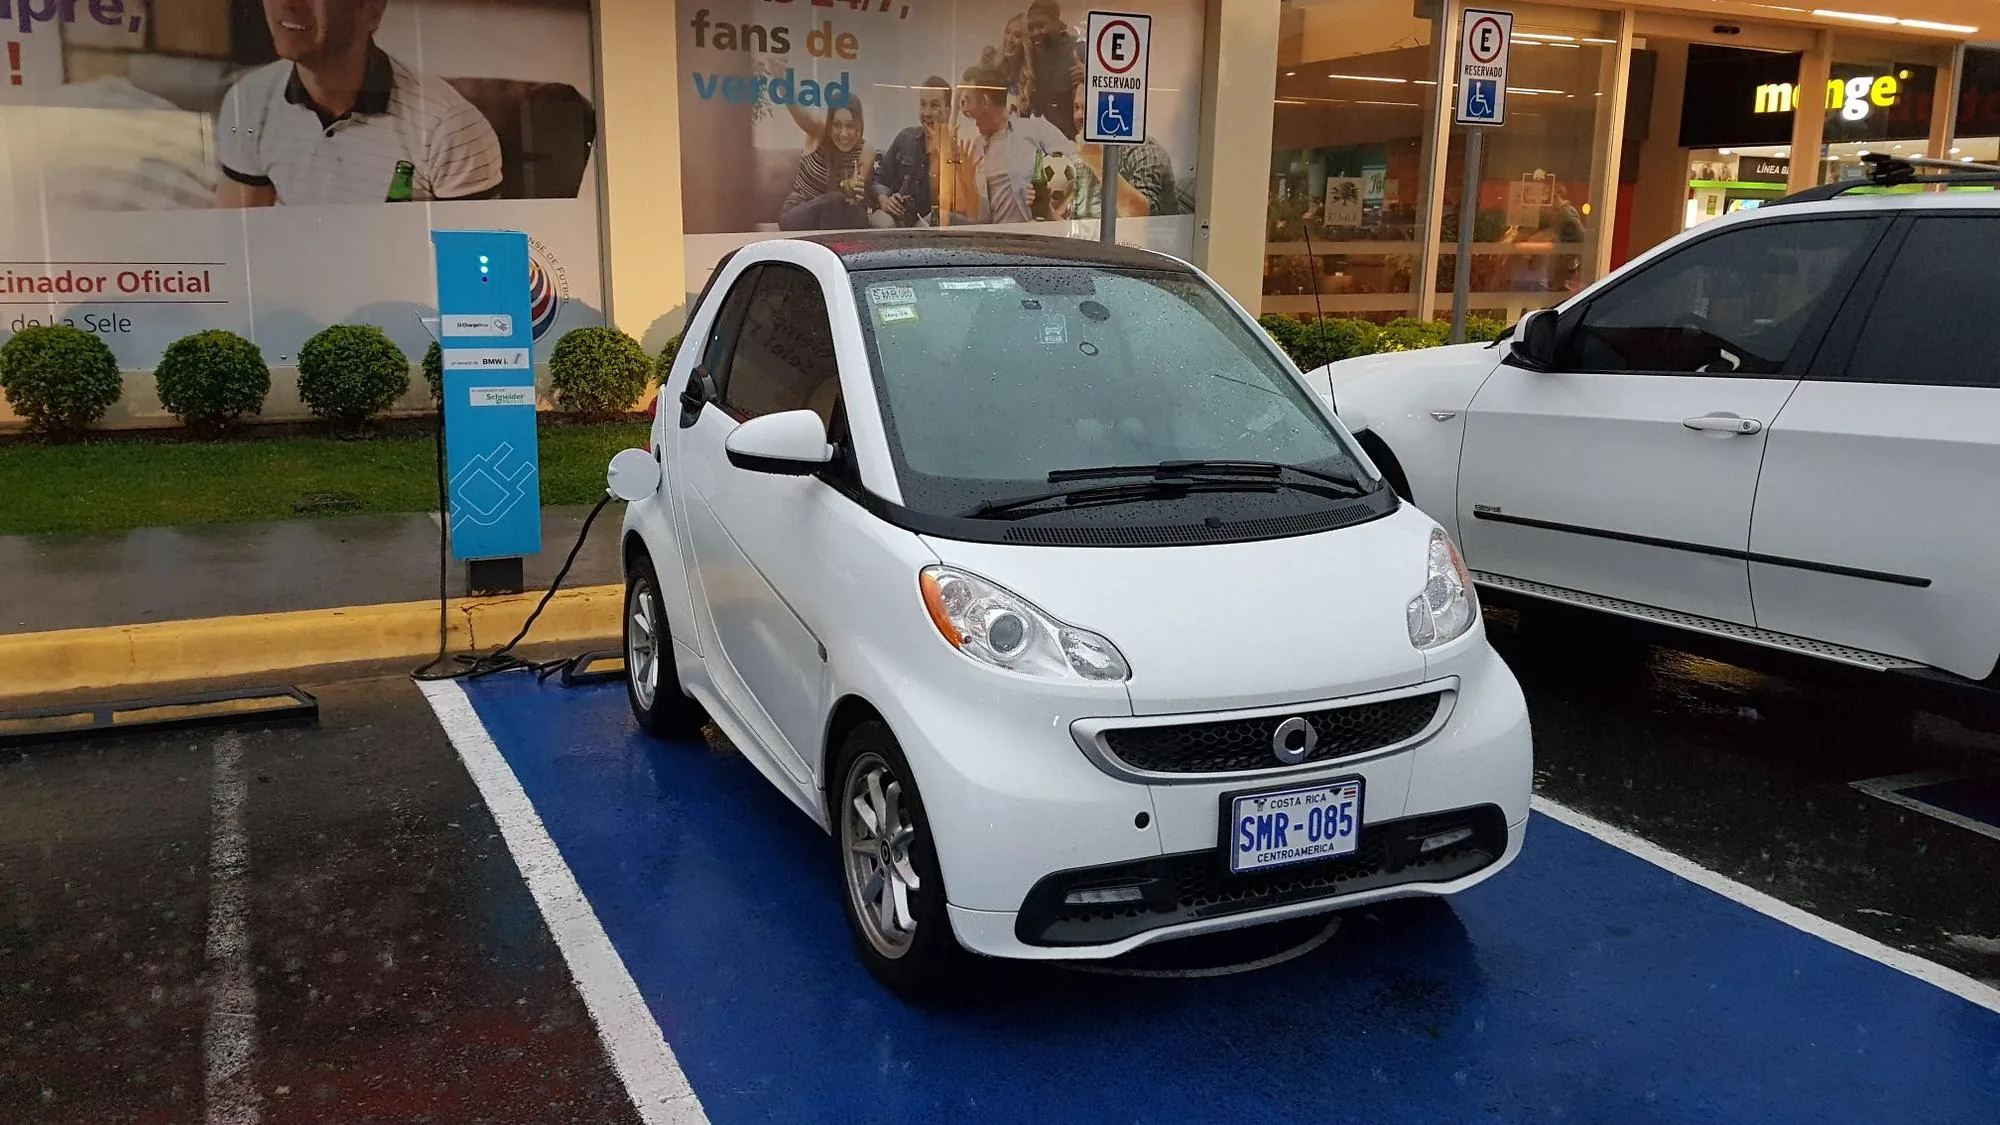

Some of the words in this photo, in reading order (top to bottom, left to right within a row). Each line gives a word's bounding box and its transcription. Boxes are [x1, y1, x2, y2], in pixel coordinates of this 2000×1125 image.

[0, 0, 142, 33] pre,
[690, 8, 791, 54] fans
[806, 20, 859, 60] de
[1480, 27, 1492, 52] E
[1111, 33, 1125, 61] E
[1092, 76, 1141, 90] RESERVADO
[1464, 65, 1503, 78] RESERVADO
[692, 68, 850, 109] verdad
[1757, 162, 1780, 175] LÍNEA
[117, 270, 211, 294] Oficial
[11, 313, 41, 335] de
[83, 312, 132, 334] Sele
[482, 358, 503, 366] BMW
[486, 393, 525, 402] Schneider
[1270, 798, 1302, 810] COSTA
[1305, 793, 1328, 806] RICA
[1240, 801, 1353, 853] SMR-085
[1257, 842, 1335, 863] CENTROAMERICA
